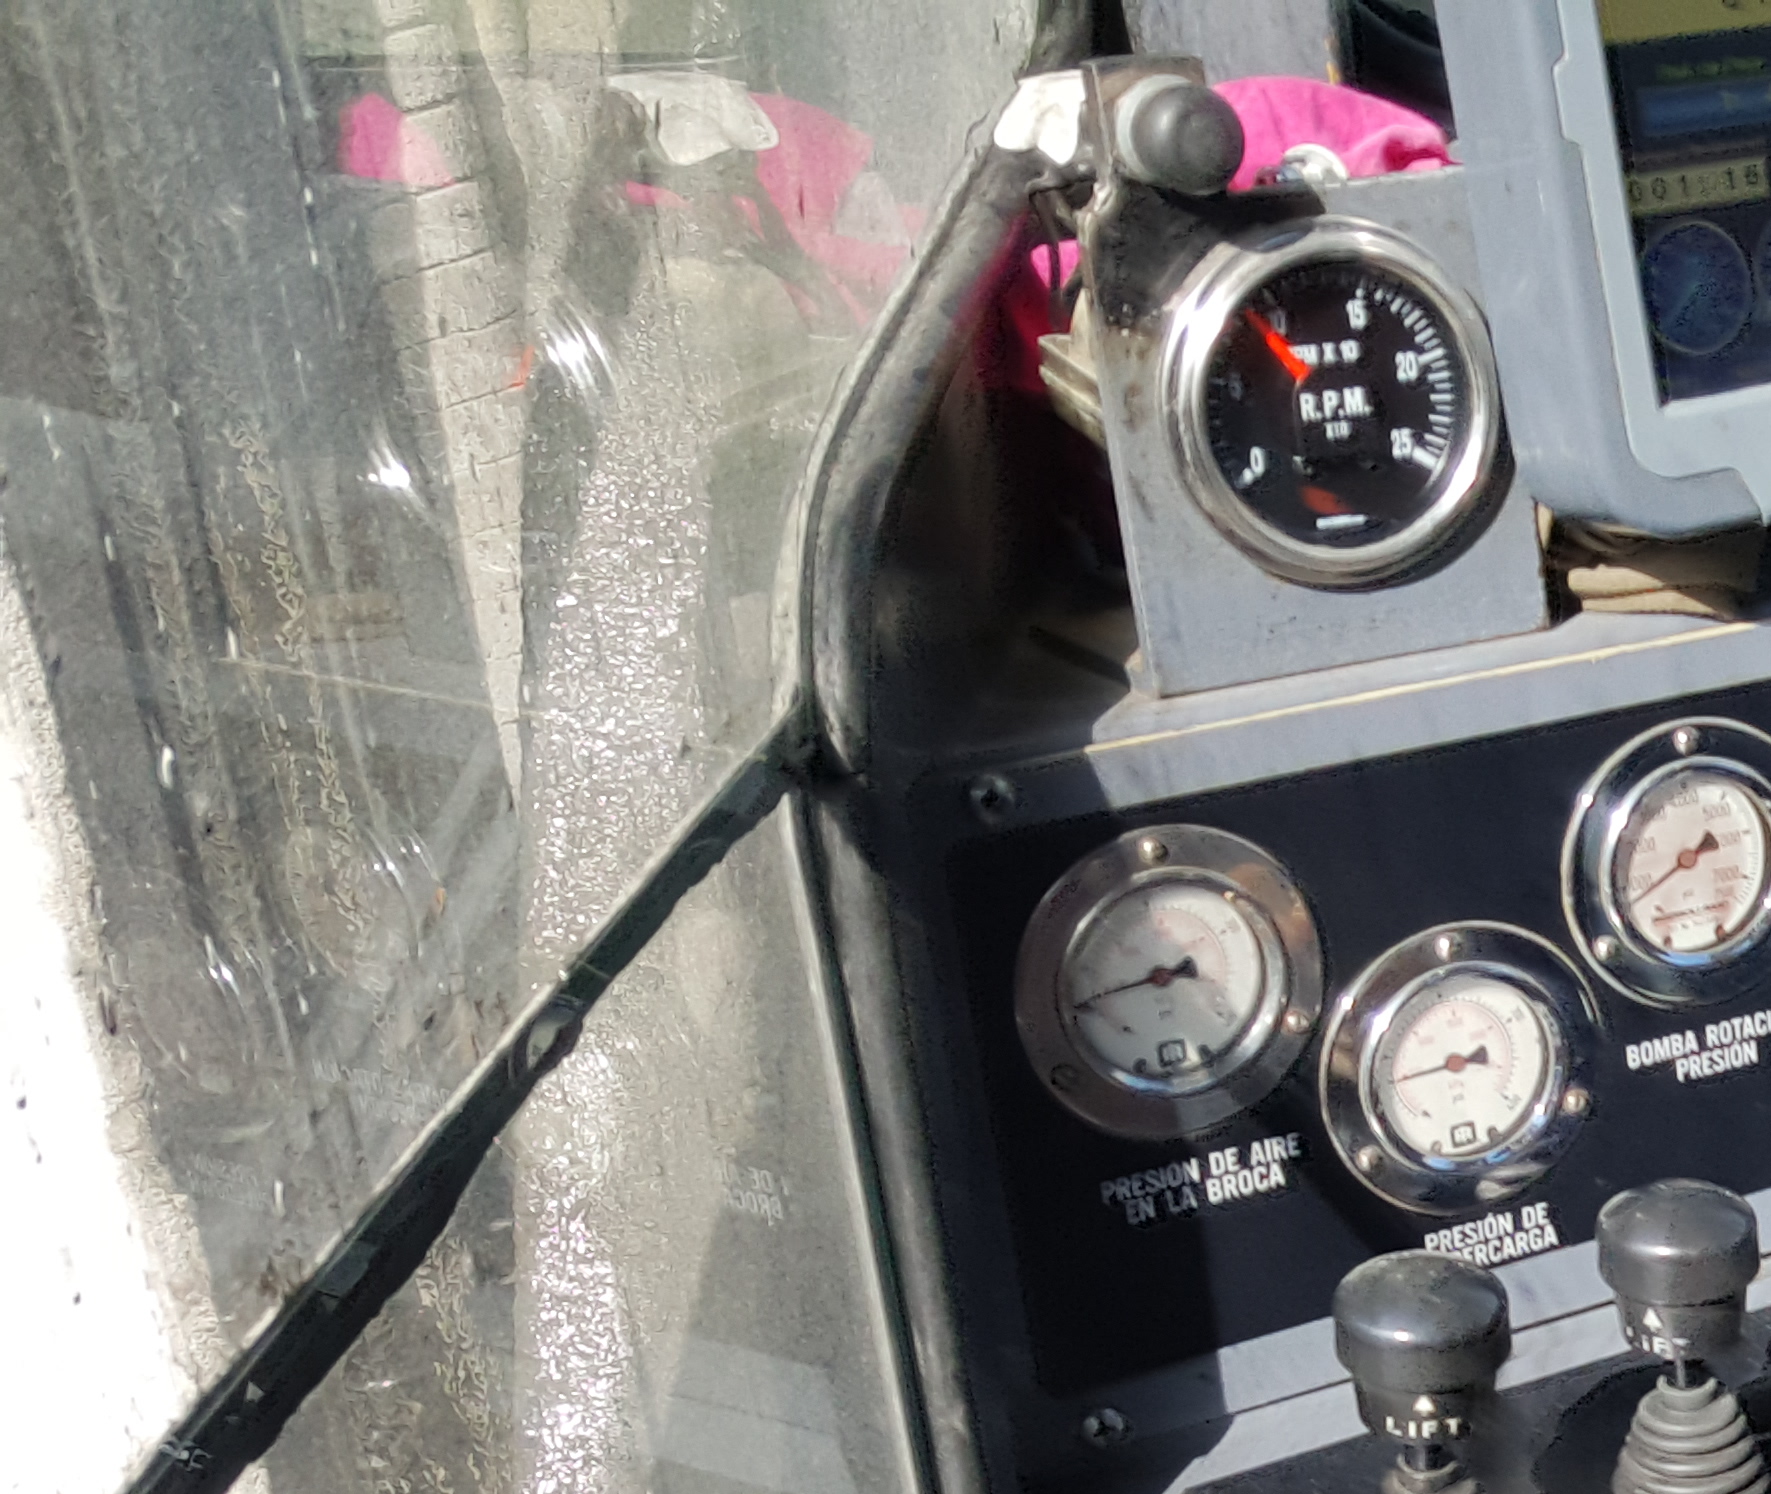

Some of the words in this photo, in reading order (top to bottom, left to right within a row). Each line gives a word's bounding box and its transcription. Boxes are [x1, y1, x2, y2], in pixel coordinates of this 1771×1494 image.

[1346, 299, 1369, 330] 15
[1322, 342, 1336, 363] X
[1339, 339, 1361, 363] 10
[1395, 351, 1419, 382] 20
[1299, 386, 1374, 422] R.P.M.
[1250, 446, 1266, 477] 0
[1391, 427, 1416, 460] 25
[1625, 1029, 1700, 1071] BOMBA
[1675, 1039, 1759, 1084] PRESIÓN
[1208, 1146, 1241, 1177] DE
[1250, 1132, 1301, 1167] AIRE
[1126, 1195, 1156, 1226] EN
[1166, 1185, 1198, 1214] LA
[1205, 1163, 1286, 1206] BROCA
[1424, 1212, 1514, 1252] PRESIÓN
[1521, 1201, 1551, 1230] DE
